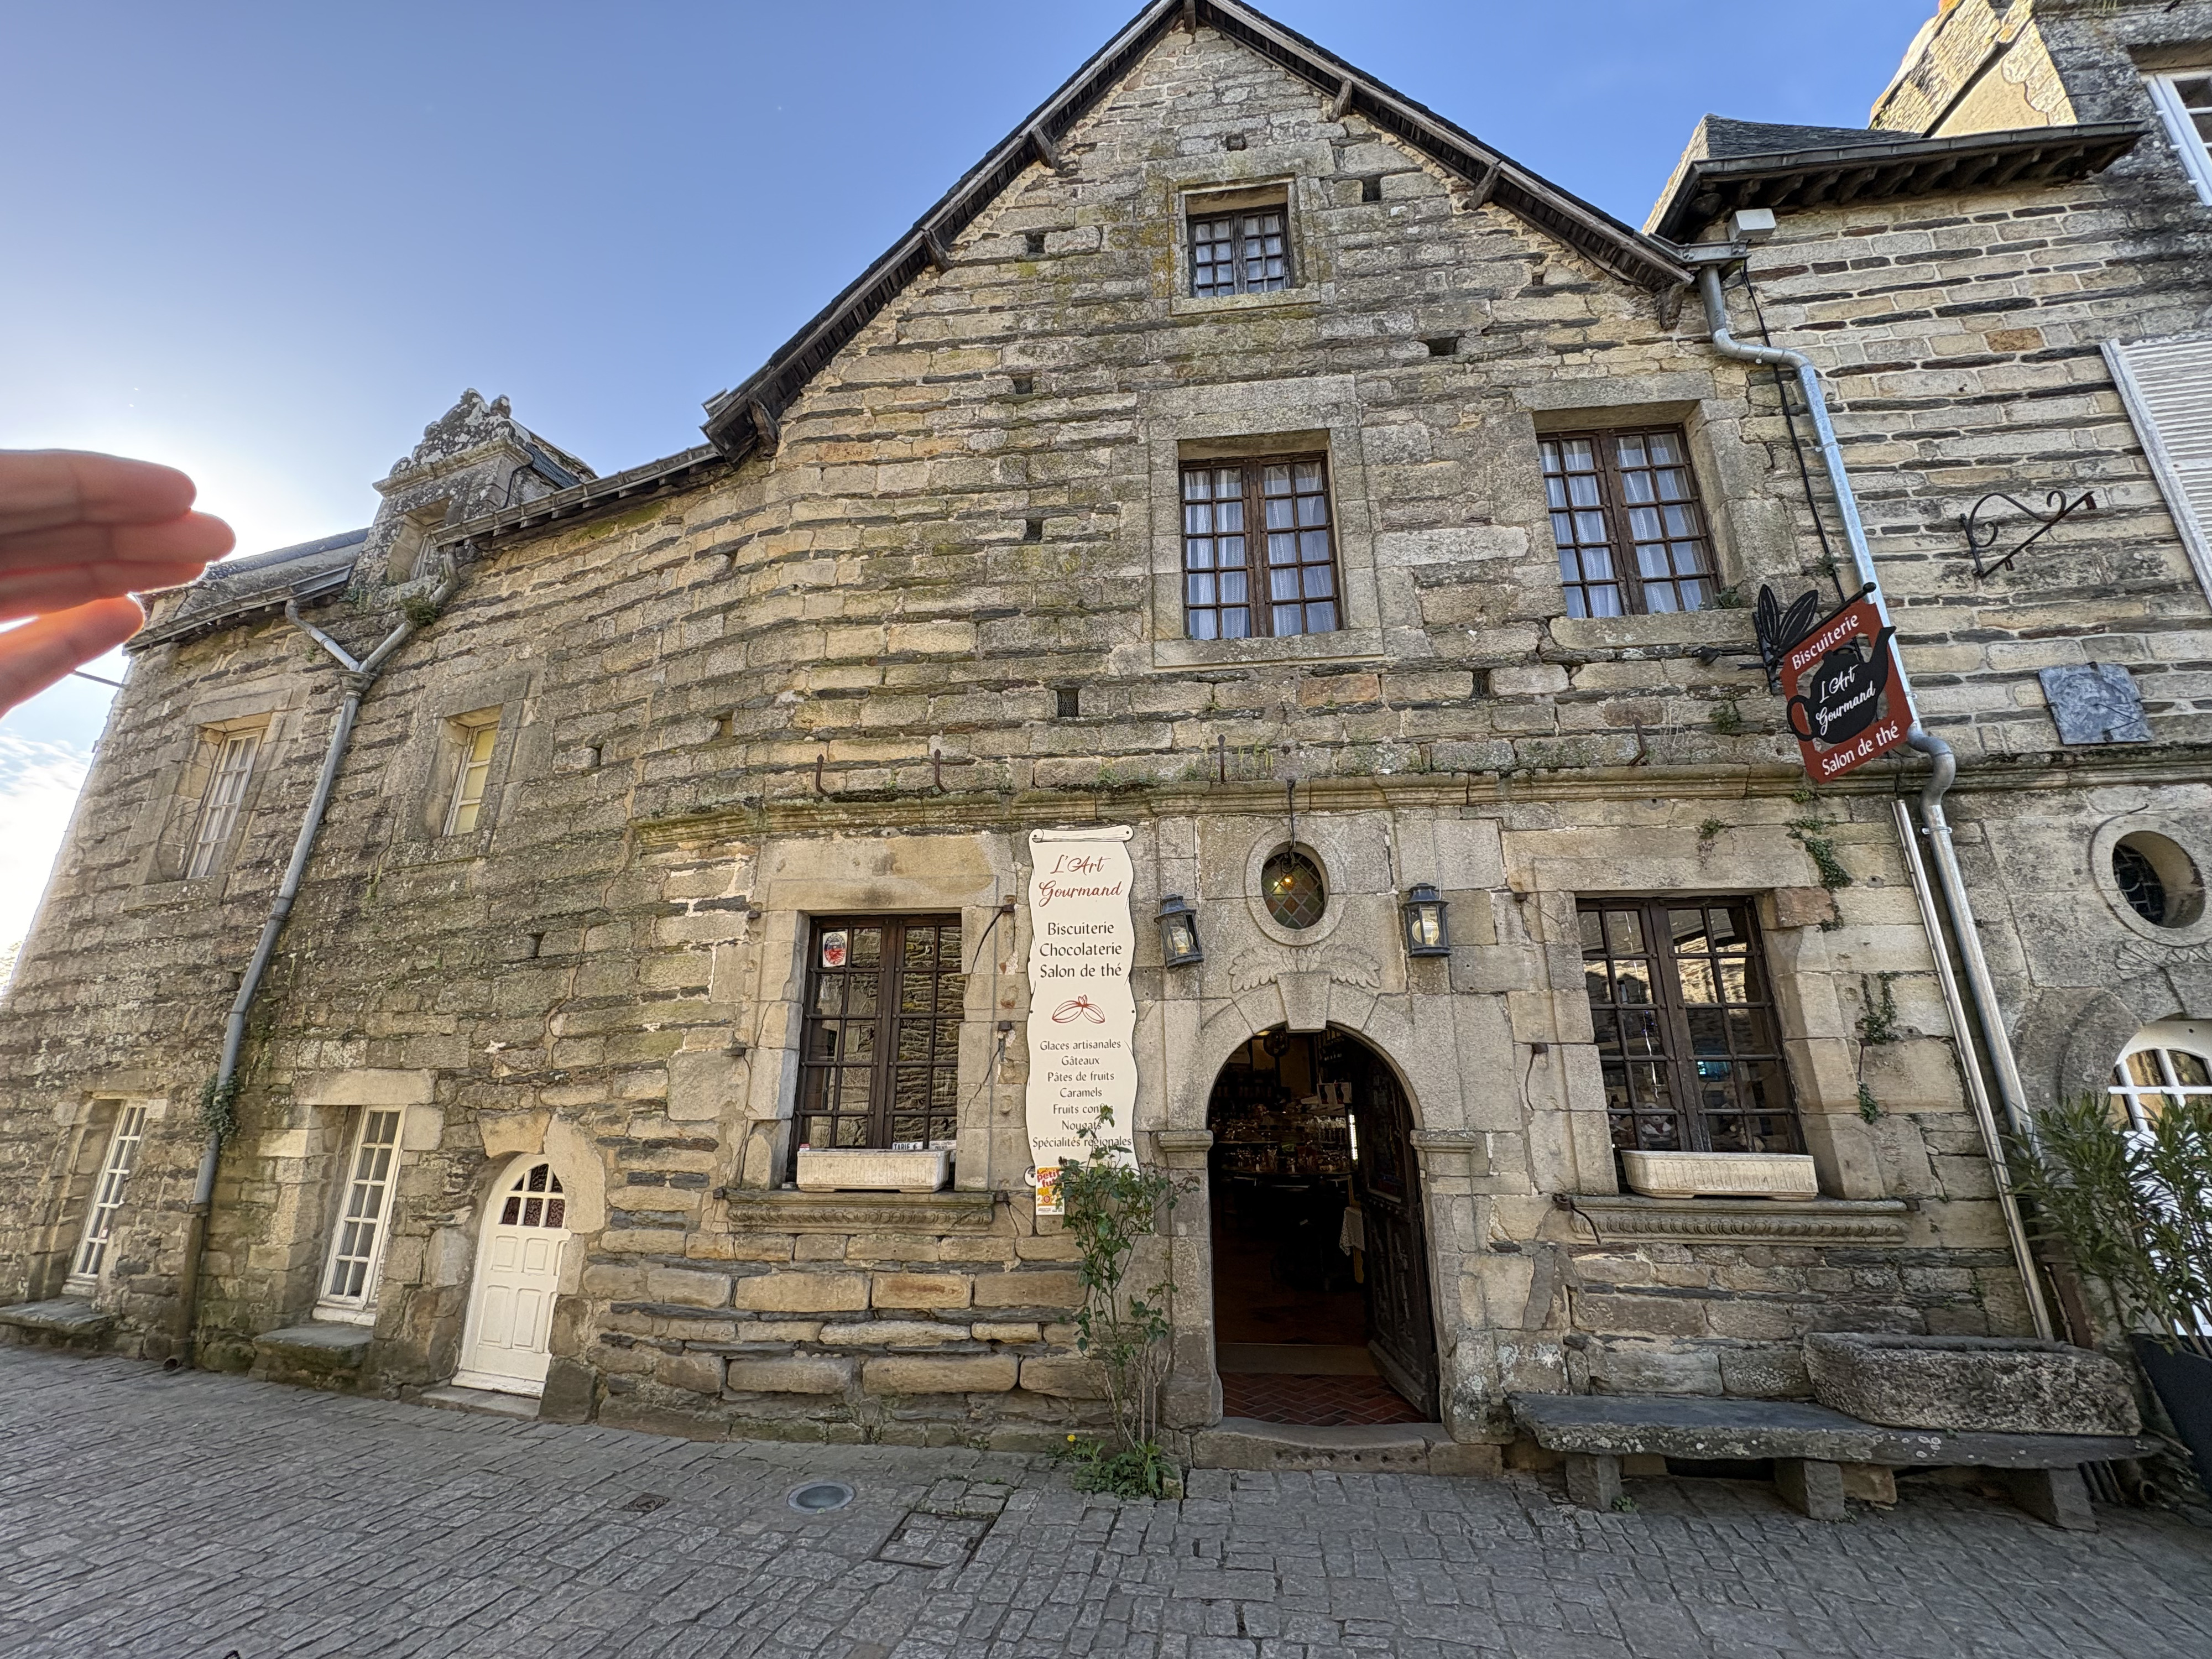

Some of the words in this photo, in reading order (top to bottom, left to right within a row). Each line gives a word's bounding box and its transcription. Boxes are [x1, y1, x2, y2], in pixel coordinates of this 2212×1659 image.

[1791, 614, 1860, 670] Biscuiterie
[1816, 680, 1876, 736] Gourmand
[1822, 750, 1855, 776] Salon
[1858, 738, 1874, 757] de
[1876, 720, 1900, 747] thé
[1050, 854, 1112, 875] L'Art
[1039, 880, 1123, 907] Gourmand
[1048, 921, 1114, 935] Biscuiterie
[1040, 942, 1122, 957] Chocolaterie
[1040, 964, 1075, 978] Salon
[1080, 963, 1095, 977] de
[1100, 962, 1122, 976] thé
[1040, 1040, 1070, 1051] Glaces
[1073, 1039, 1121, 1050] artisanales
[1061, 1055, 1100, 1066] Gâteaux
[1047, 1072, 1073, 1082] Pâtes
[1076, 1071, 1087, 1082] de
[1090, 1071, 1115, 1081] fruits
[1060, 1087, 1103, 1098] Caramels
[1053, 1104, 1079, 1114] Fruits
[1082, 1103, 1114, 1114] conf
[1062, 1120, 1102, 1131] Nougats
[1032, 1136, 1081, 1150] Spécialités
[1084, 1135, 1132, 1150] régionales
